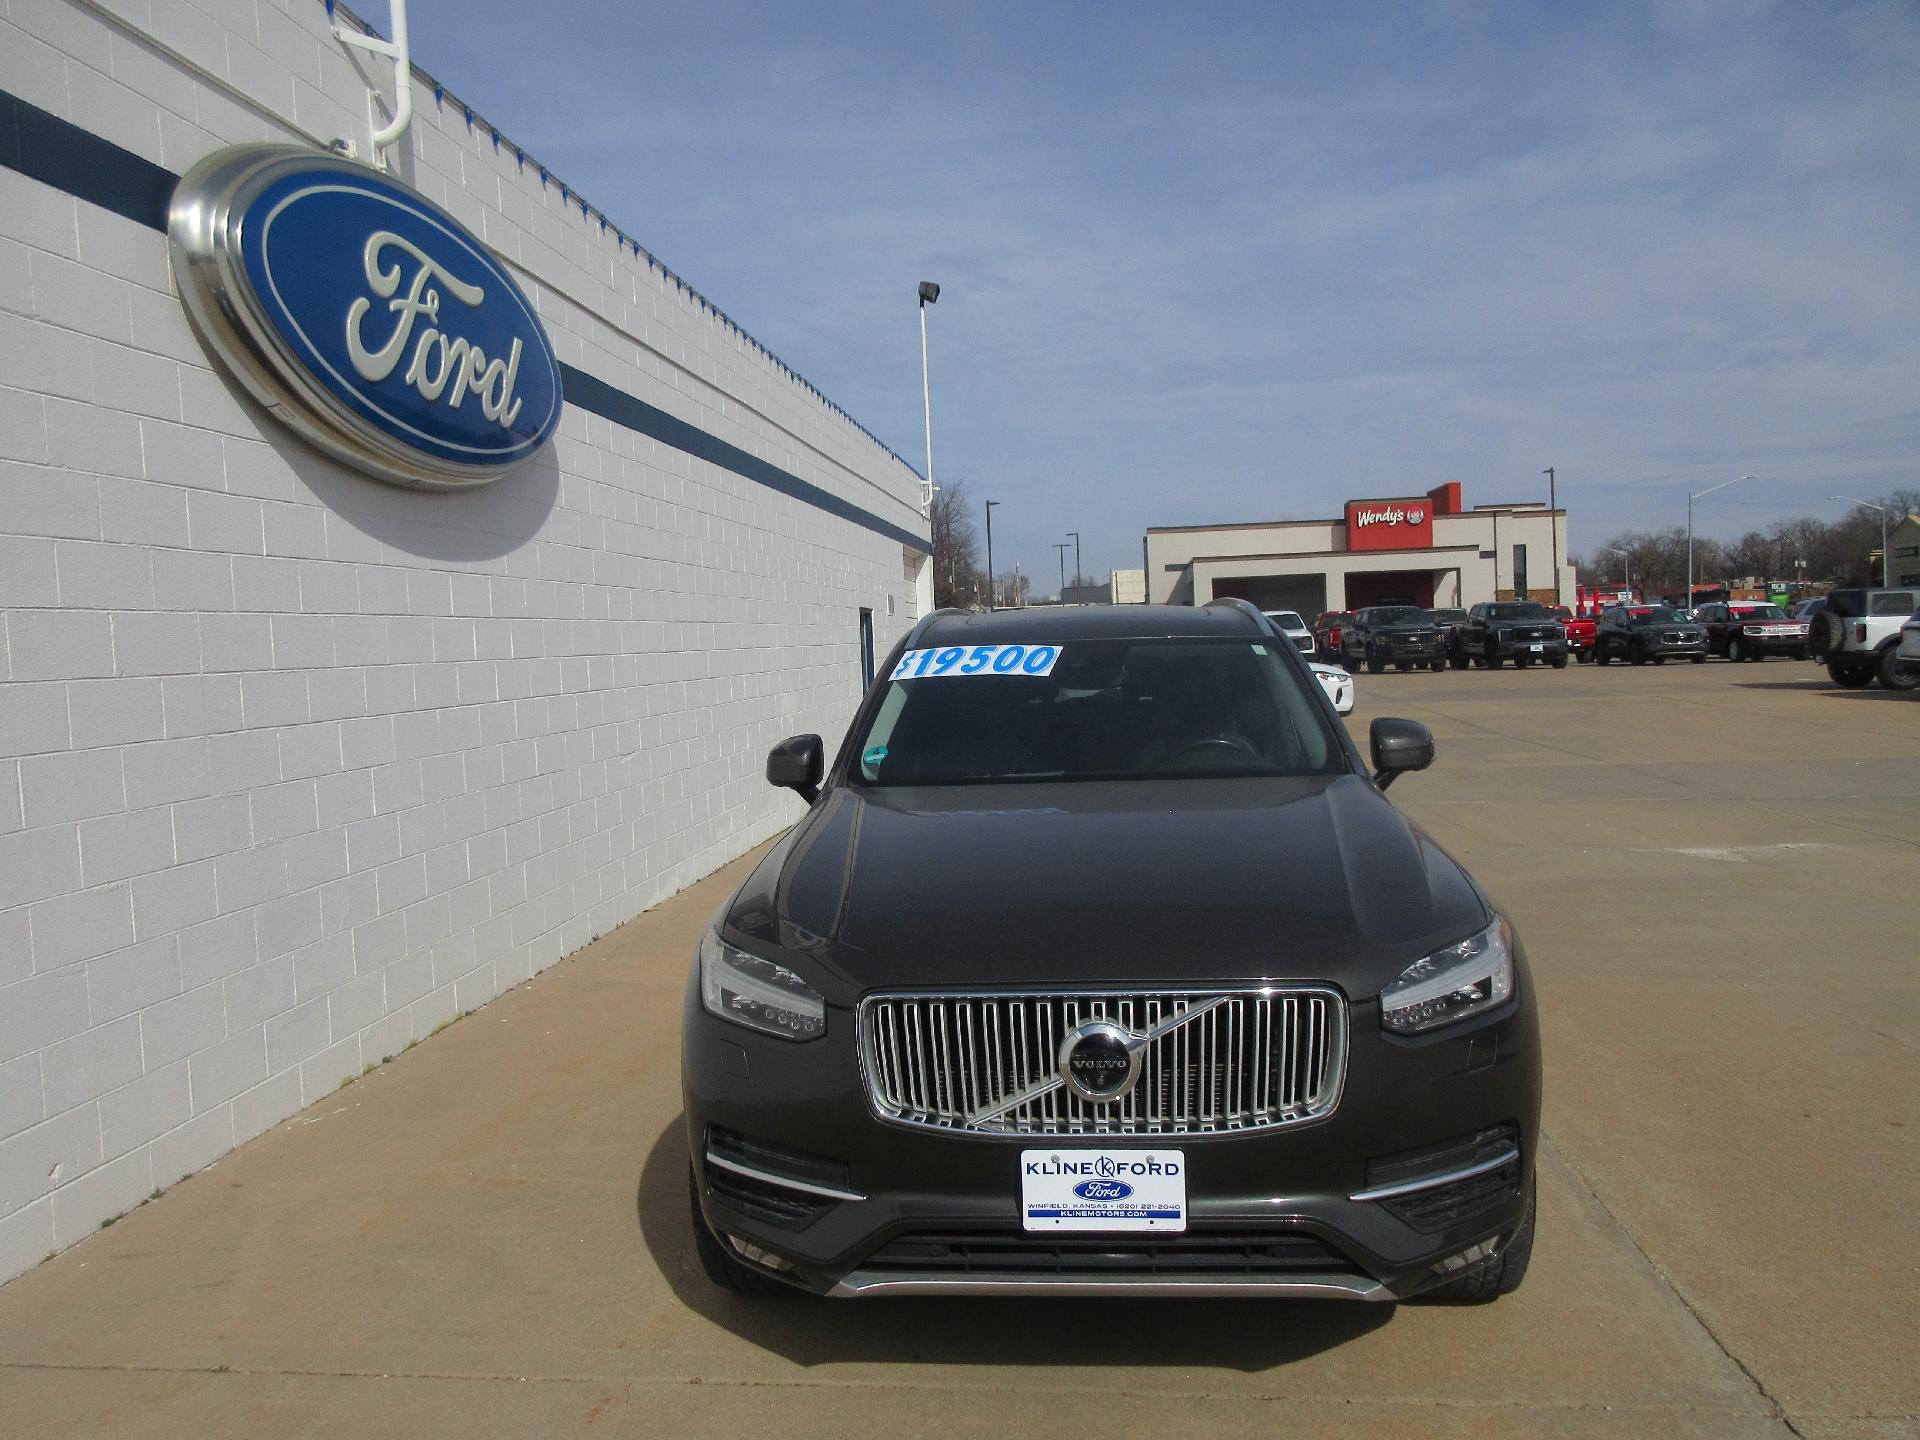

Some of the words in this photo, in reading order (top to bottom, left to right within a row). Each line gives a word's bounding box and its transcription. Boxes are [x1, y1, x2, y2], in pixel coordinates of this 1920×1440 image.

[346, 231, 523, 428] Ford
[1358, 506, 1403, 528] Wendy's
[895, 645, 1057, 678] $19500
[1073, 1060, 1126, 1069] VOLVO
[1026, 1162, 1093, 1175] KLINE
[1117, 1162, 1179, 1176] FORD
[1084, 1182, 1121, 1198] Ford
